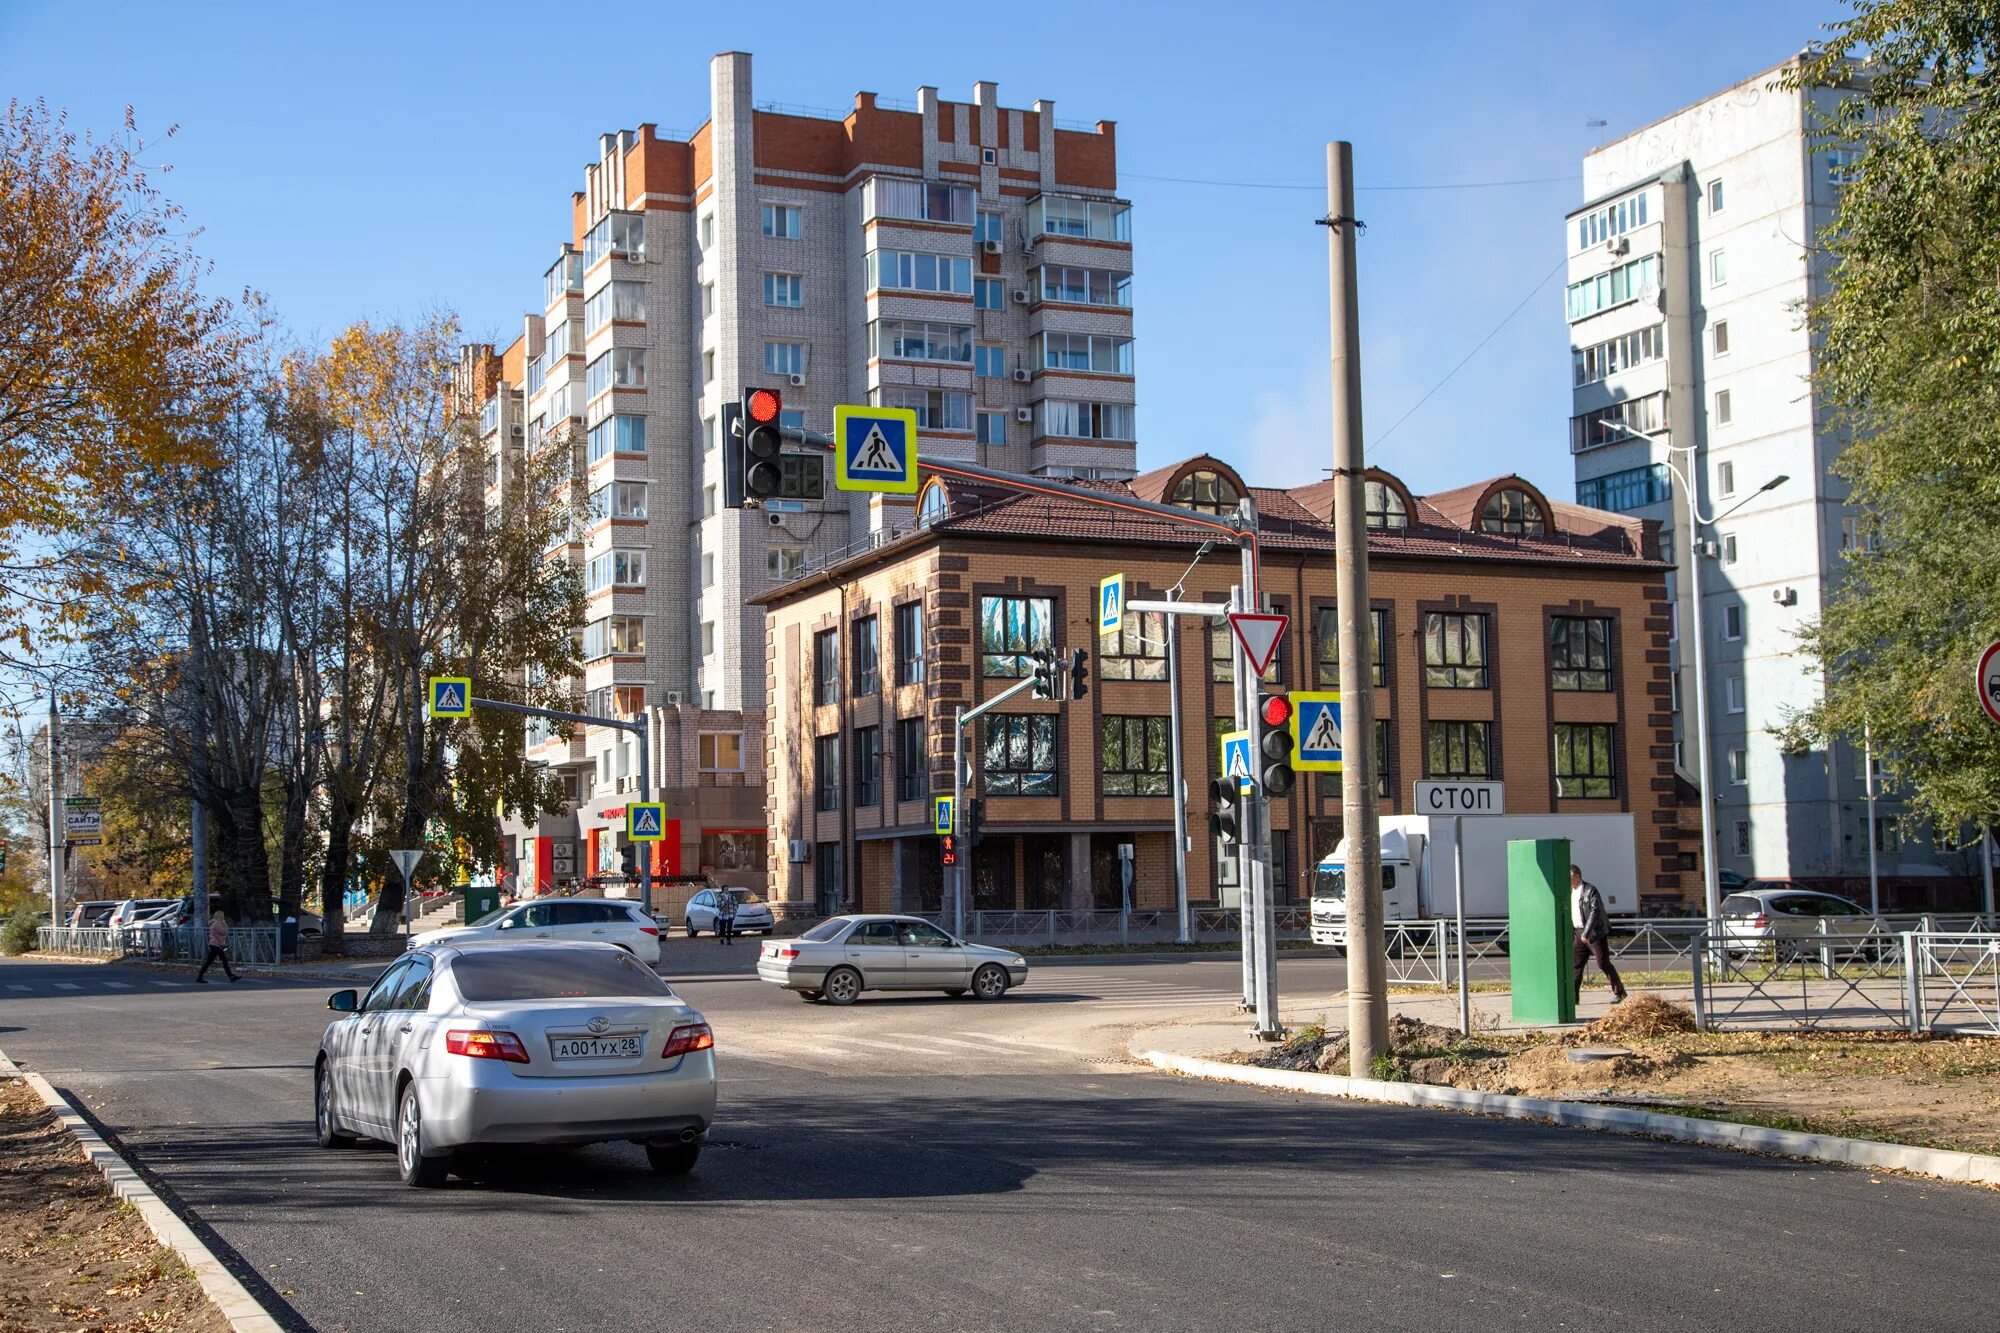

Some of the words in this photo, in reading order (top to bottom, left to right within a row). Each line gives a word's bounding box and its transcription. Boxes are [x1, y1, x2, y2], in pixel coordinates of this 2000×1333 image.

[1429, 787, 1491, 810] СТОП
[67, 815, 100, 824] САЙТЫ
[560, 1041, 618, 1056] А001УХ
[621, 1038, 636, 1050] 28
